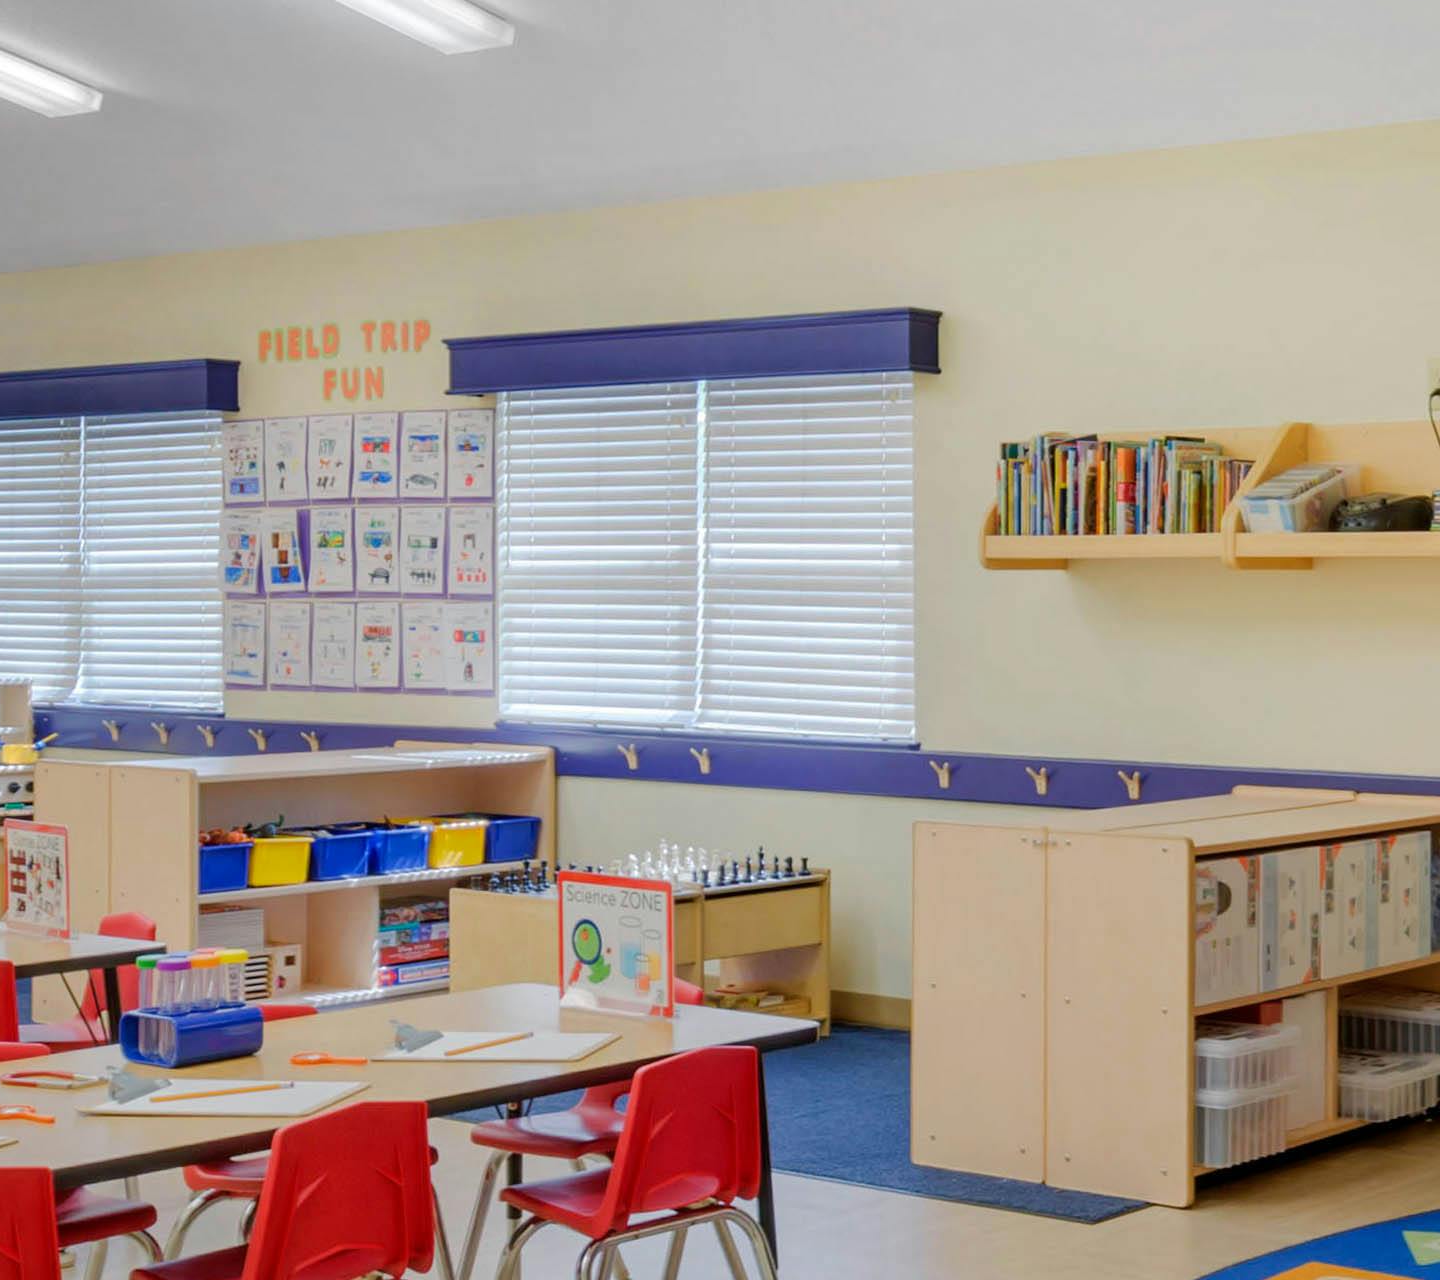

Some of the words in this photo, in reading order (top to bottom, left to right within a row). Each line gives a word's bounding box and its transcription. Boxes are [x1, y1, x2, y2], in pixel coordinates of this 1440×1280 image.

[258, 322, 341, 363] FIELD
[360, 318, 432, 354] TRIP
[322, 365, 386, 402] FUN
[35, 834, 60, 852] ZONE
[566, 884, 617, 907] Science
[620, 890, 663, 912] ZONE
